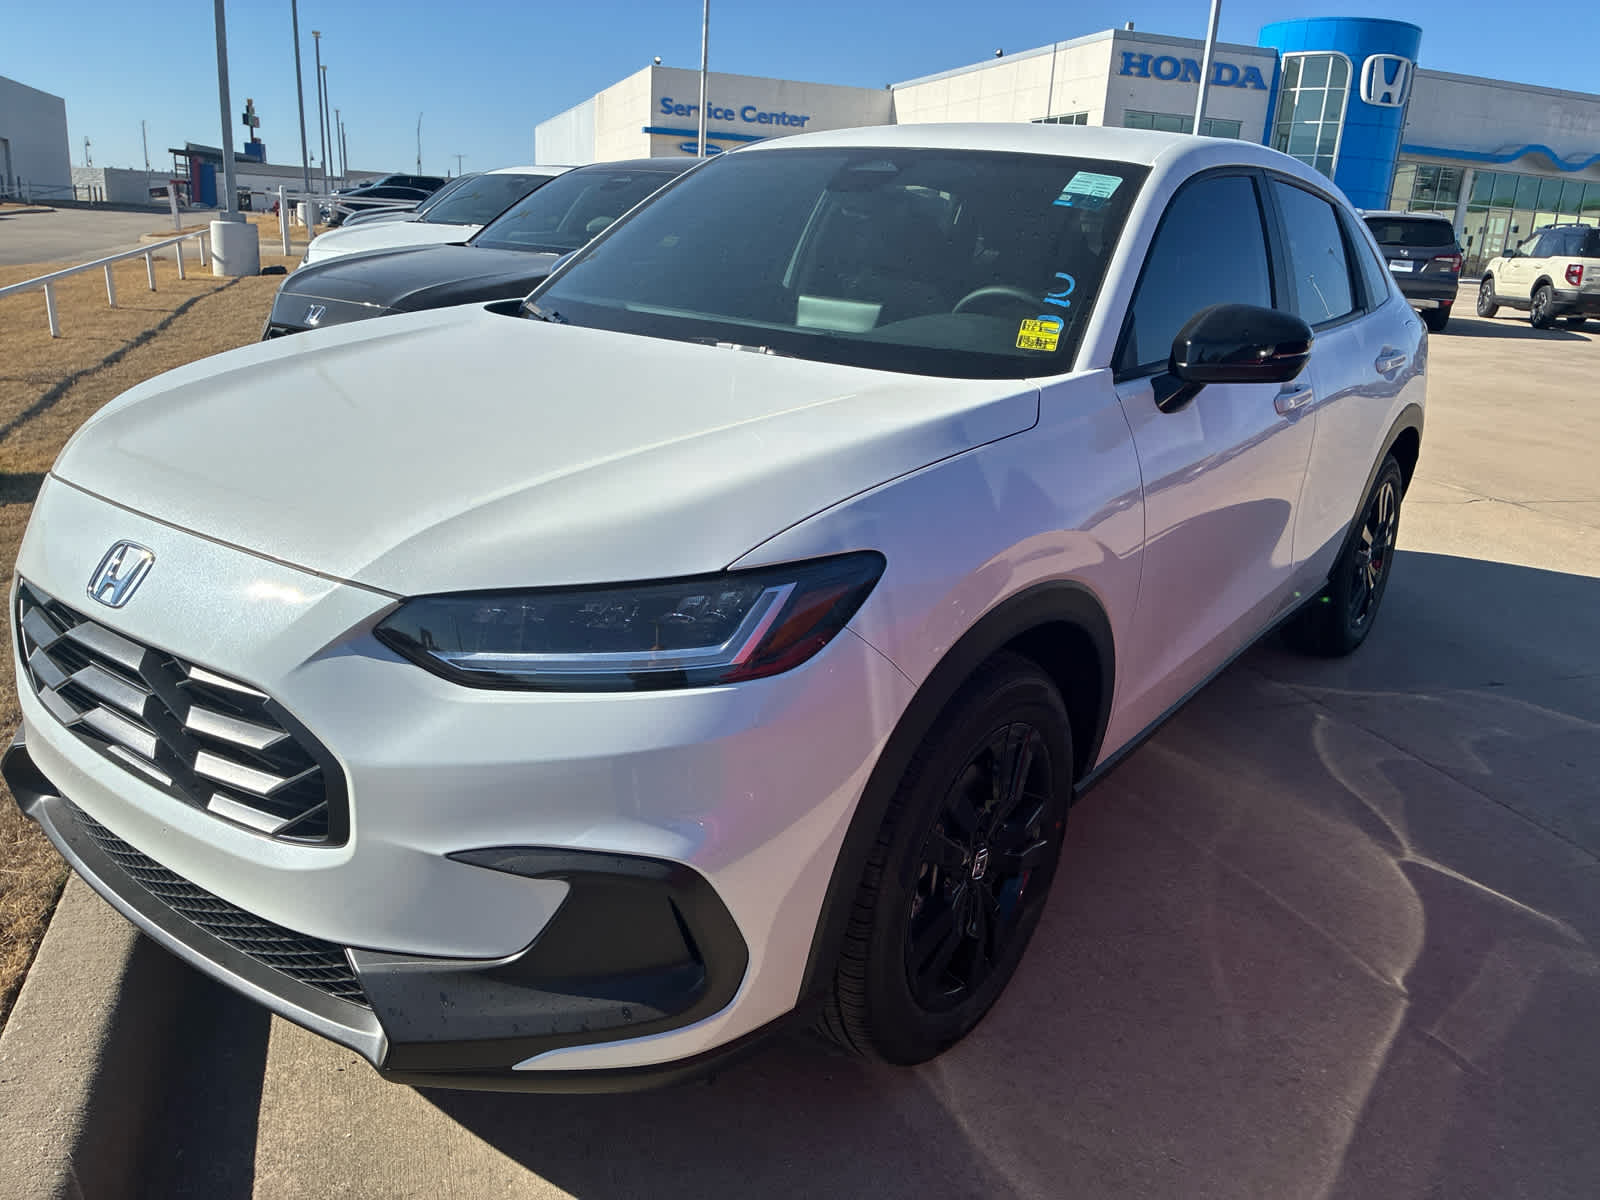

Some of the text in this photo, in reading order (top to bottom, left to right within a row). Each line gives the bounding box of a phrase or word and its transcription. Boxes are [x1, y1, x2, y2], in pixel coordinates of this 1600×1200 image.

[1119, 52, 1268, 90] HONDA
[661, 97, 810, 127] Serice Center
